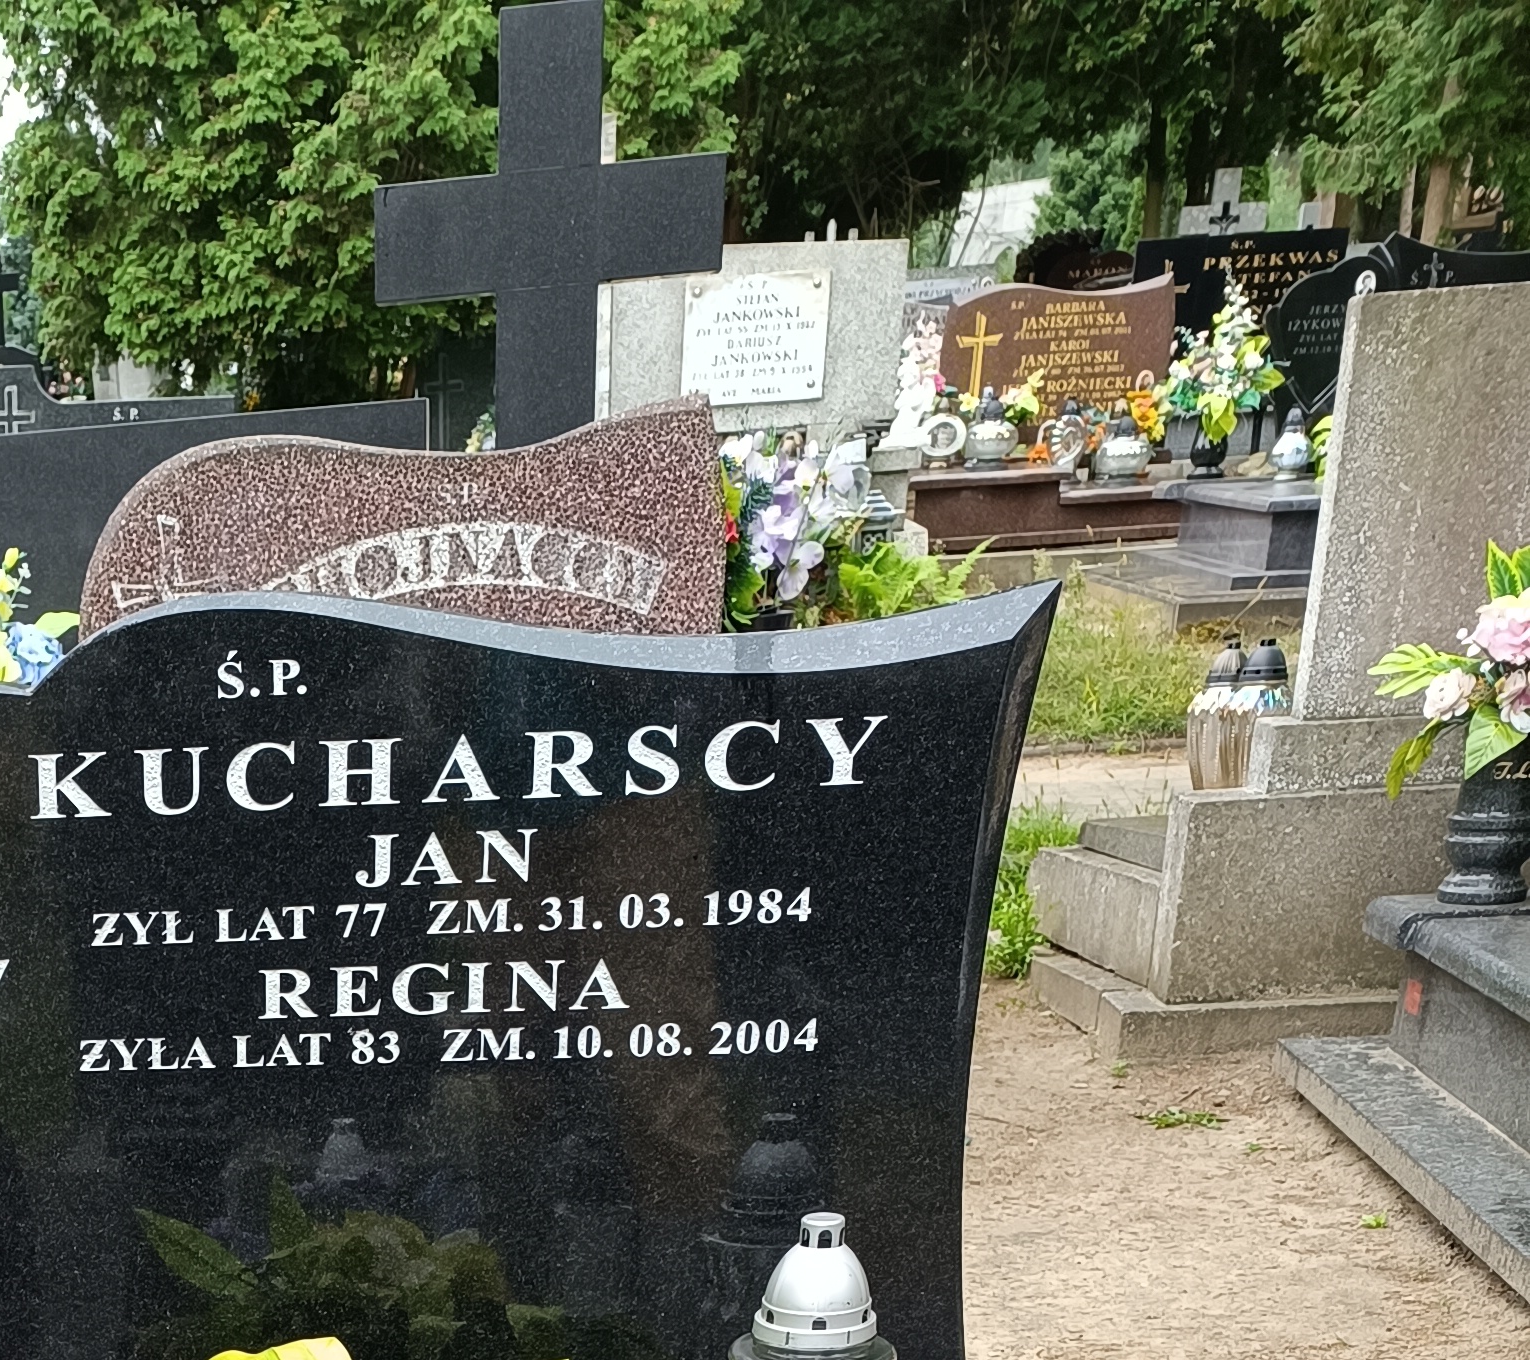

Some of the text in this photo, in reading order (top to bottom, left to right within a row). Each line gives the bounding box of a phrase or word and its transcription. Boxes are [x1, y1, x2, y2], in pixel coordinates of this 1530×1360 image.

[1203, 249, 1338, 271] PRZEKWAS
[1232, 269, 1310, 284] TEFAN
[713, 305, 800, 324] JANKOWSKI
[1045, 300, 1106, 315] BARBARA
[1021, 312, 1126, 332] JANISZEWSKA
[727, 335, 781, 349] DARIUSZ
[710, 348, 798, 367] JANKOWSKI
[27, 715, 889, 820] KUCHARSCY
[354, 827, 539, 888] JAN
[90, 886, 812, 947] ŻYŁ LAT 77 ZM. 31. 03. 1984
[257, 957, 630, 1020] REGINA
[78, 1017, 819, 1073] ŻYŁA LAT 83 ZM. 10. 08. 2004
